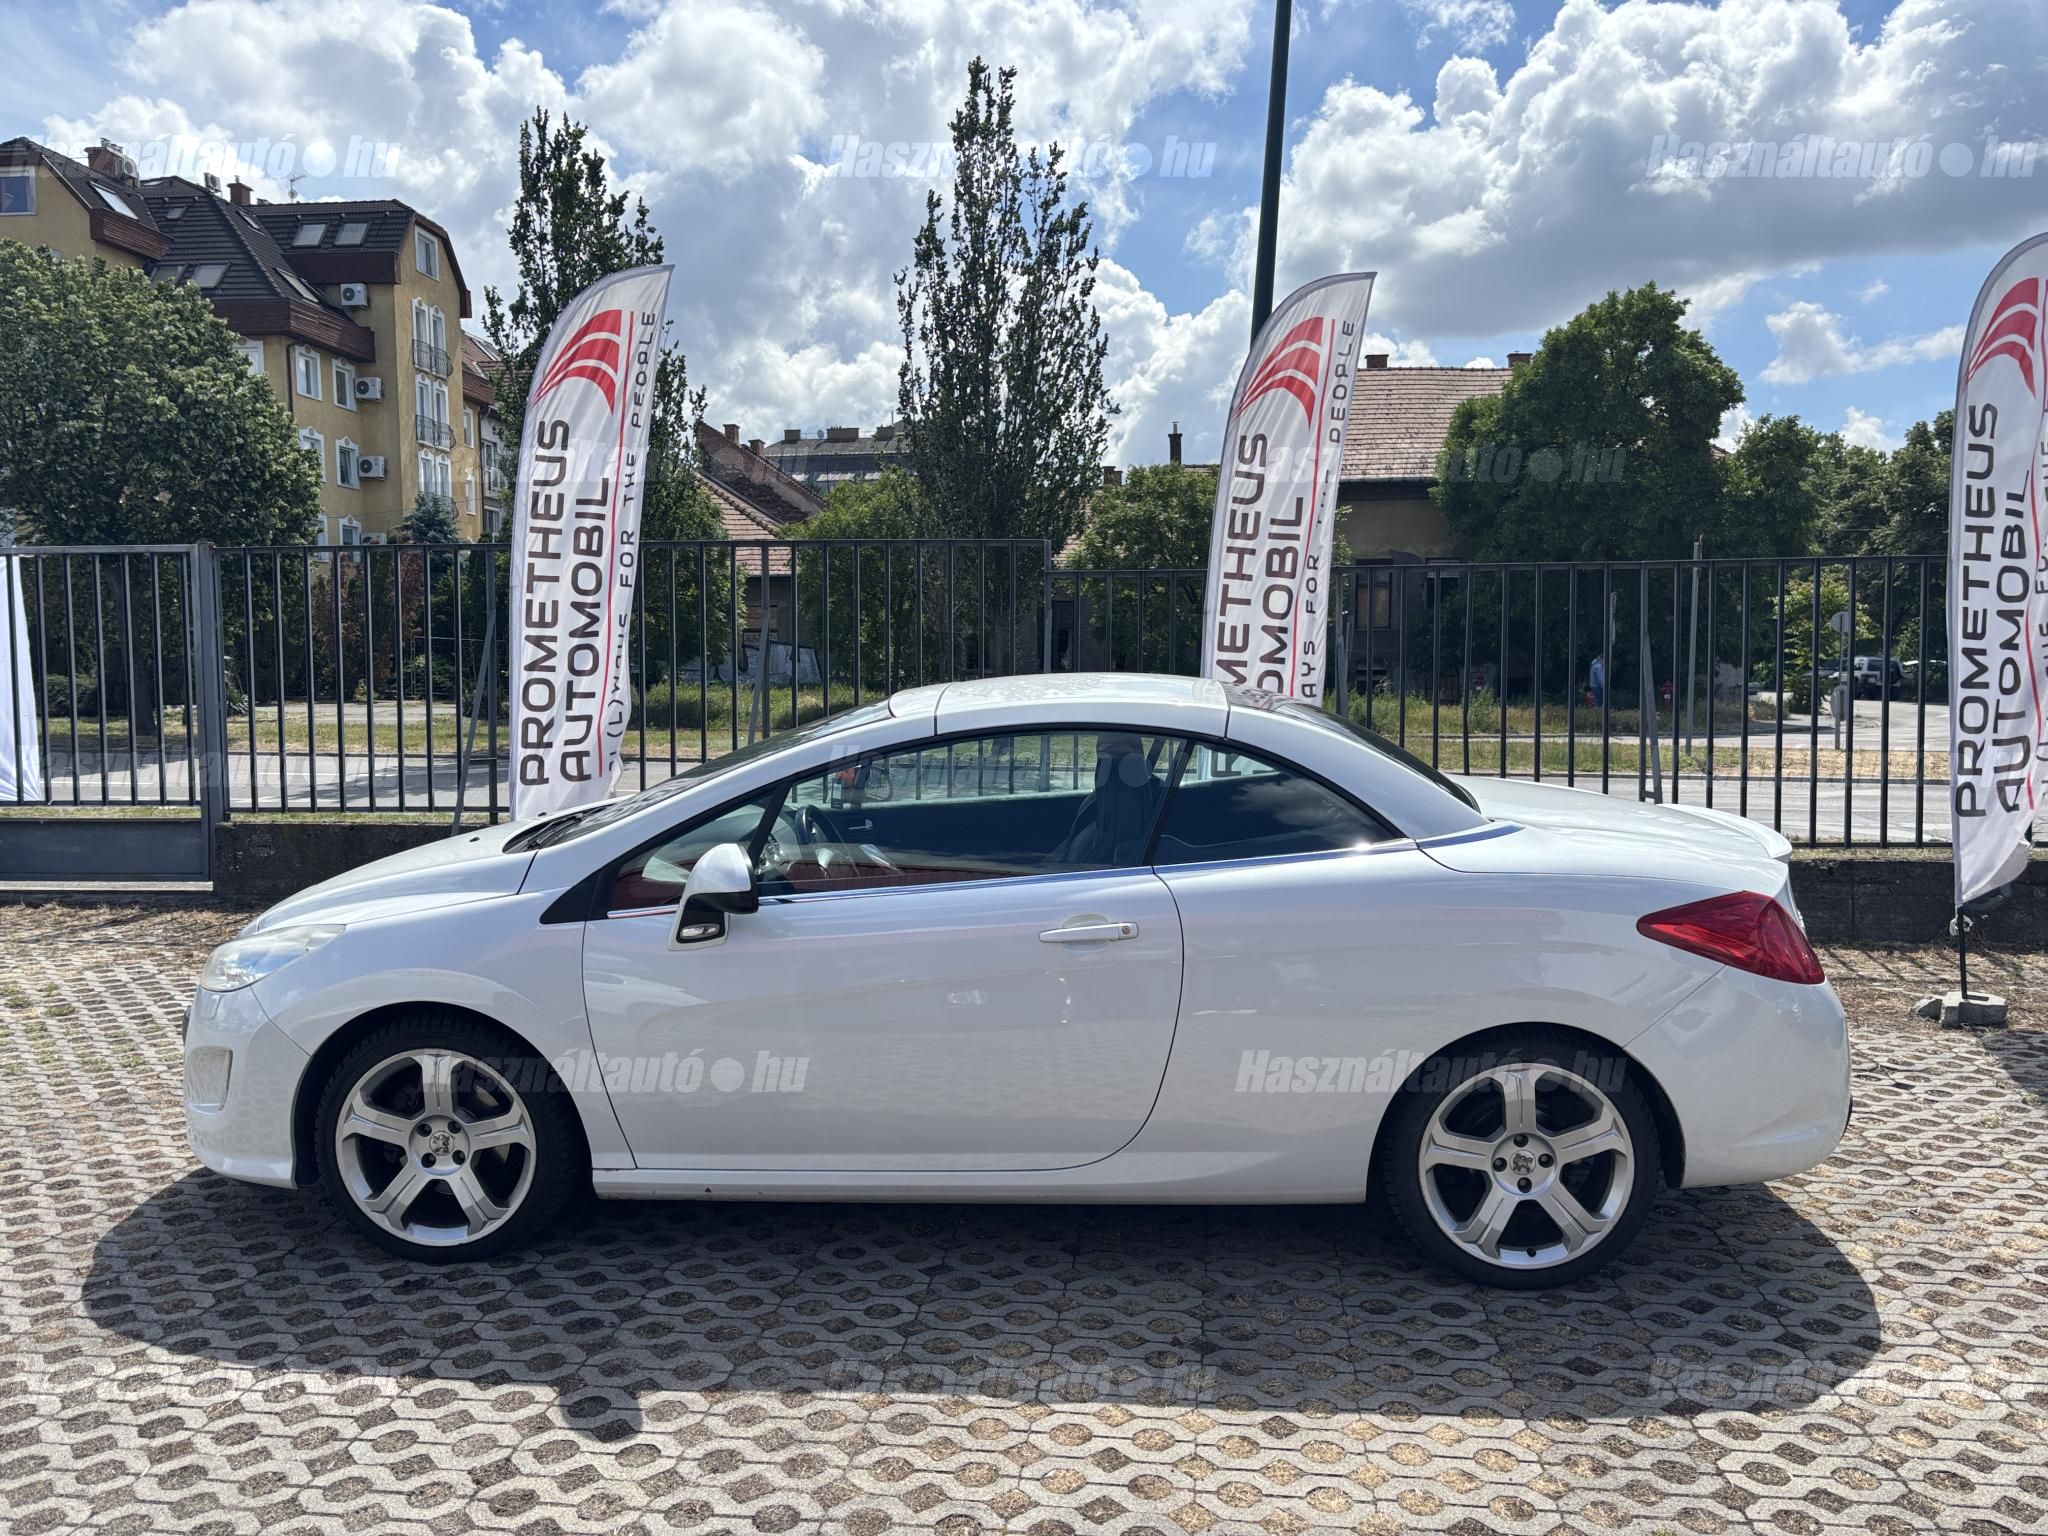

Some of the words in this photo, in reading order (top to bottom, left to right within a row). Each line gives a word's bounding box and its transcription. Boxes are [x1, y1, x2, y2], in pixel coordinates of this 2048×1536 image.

[631, 310, 656, 430] PEOPLE
[619, 529, 635, 589] FOR
[623, 453, 637, 507] THE
[1215, 431, 1268, 687] METHEUS
[519, 417, 570, 787] PROMETHEUS
[559, 476, 609, 782] AUTOMOBIL
[1256, 496, 1304, 694] OMOBIL
[1301, 639, 1317, 699] AYS
[1305, 553, 1320, 615] FOR
[1955, 402, 1998, 818] PROMETHEUS
[1991, 469, 2032, 814] AUTOMOBIL
